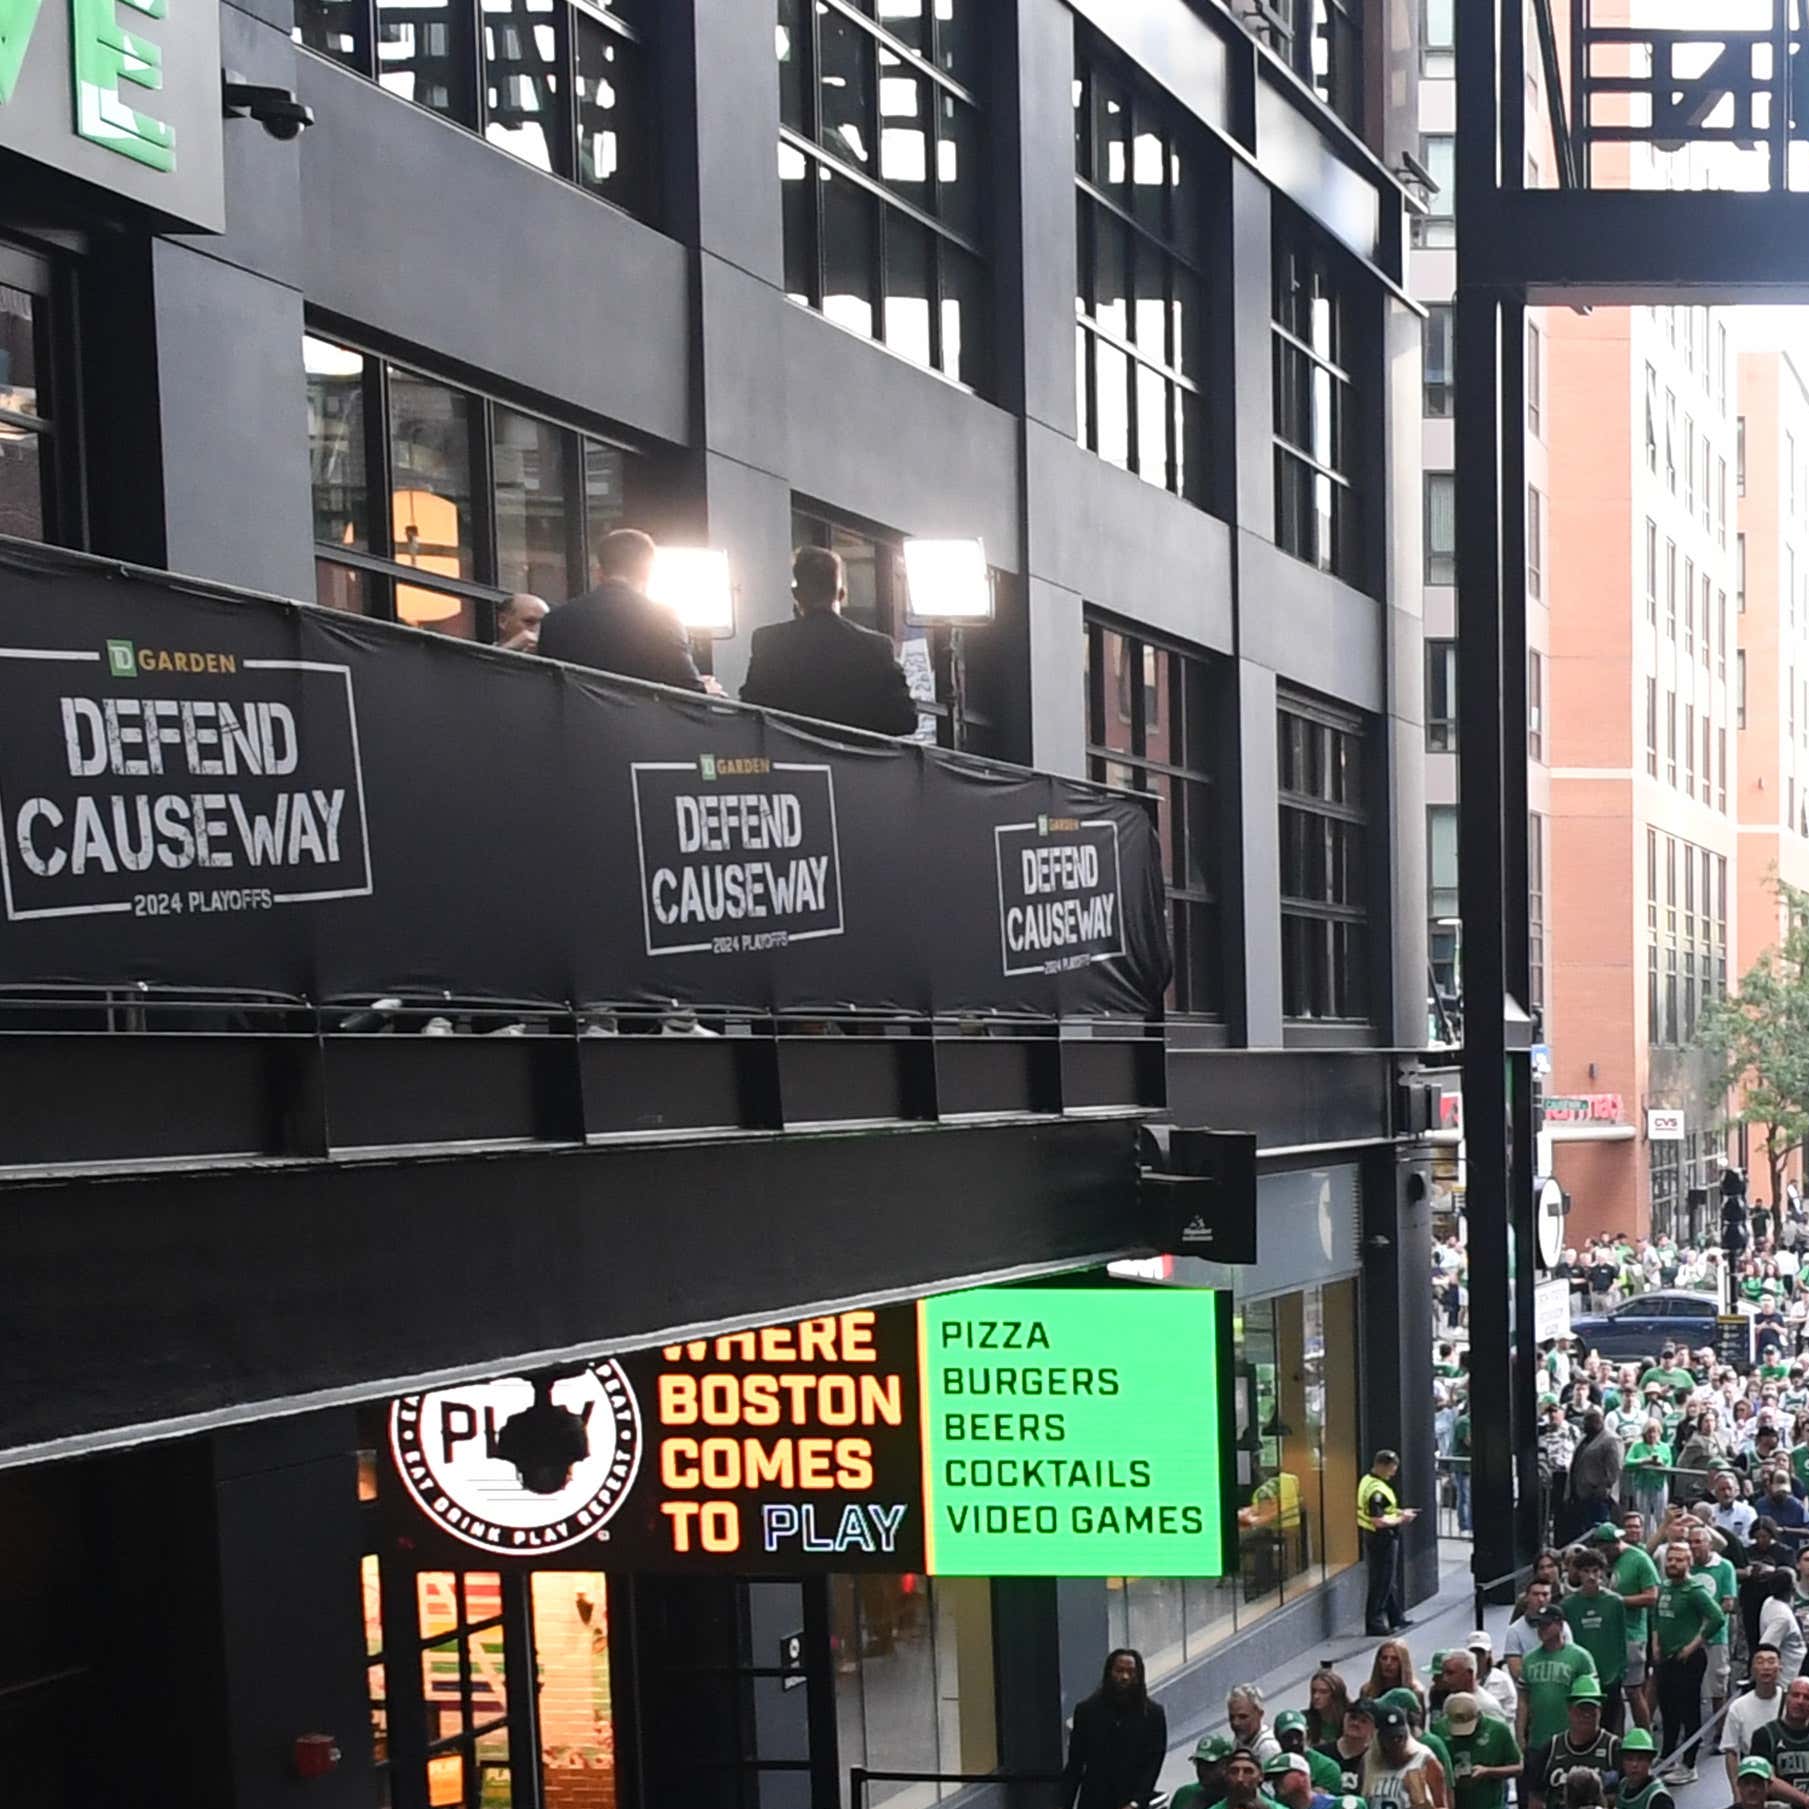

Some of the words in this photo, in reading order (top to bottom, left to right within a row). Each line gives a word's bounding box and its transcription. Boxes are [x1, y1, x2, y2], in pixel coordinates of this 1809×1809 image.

[138, 649, 237, 673] GARDEN
[60, 697, 299, 777] DEFEND
[717, 758, 770, 774] GARDEN
[16, 789, 346, 877] CAUSEWAY
[675, 794, 802, 853] DEFEND
[1021, 845, 1098, 895] DEFEND
[134, 892, 183, 916] 2024
[189, 888, 273, 913] PLAYOFFS
[652, 856, 829, 924] CAUSEWAY
[1007, 892, 1114, 952] CAUSEWAY
[713, 936, 740, 953] 2024
[1654, 1117, 1678, 1128] CVS
[942, 1321, 1050, 1349] PIZZA
[943, 1367, 1119, 1396] BURGERS
[658, 1374, 902, 1426] BOSTON
[945, 1413, 1065, 1441] BEERS
[661, 1437, 873, 1489] COMES
[945, 1459, 1151, 1488] COCKTAILS
[513, 1522, 569, 1545] PLAY
[661, 1501, 740, 1552] TO
[763, 1504, 907, 1552] PLAY
[946, 1505, 1057, 1534] VIDEO
[1072, 1505, 1203, 1534] GAMES
